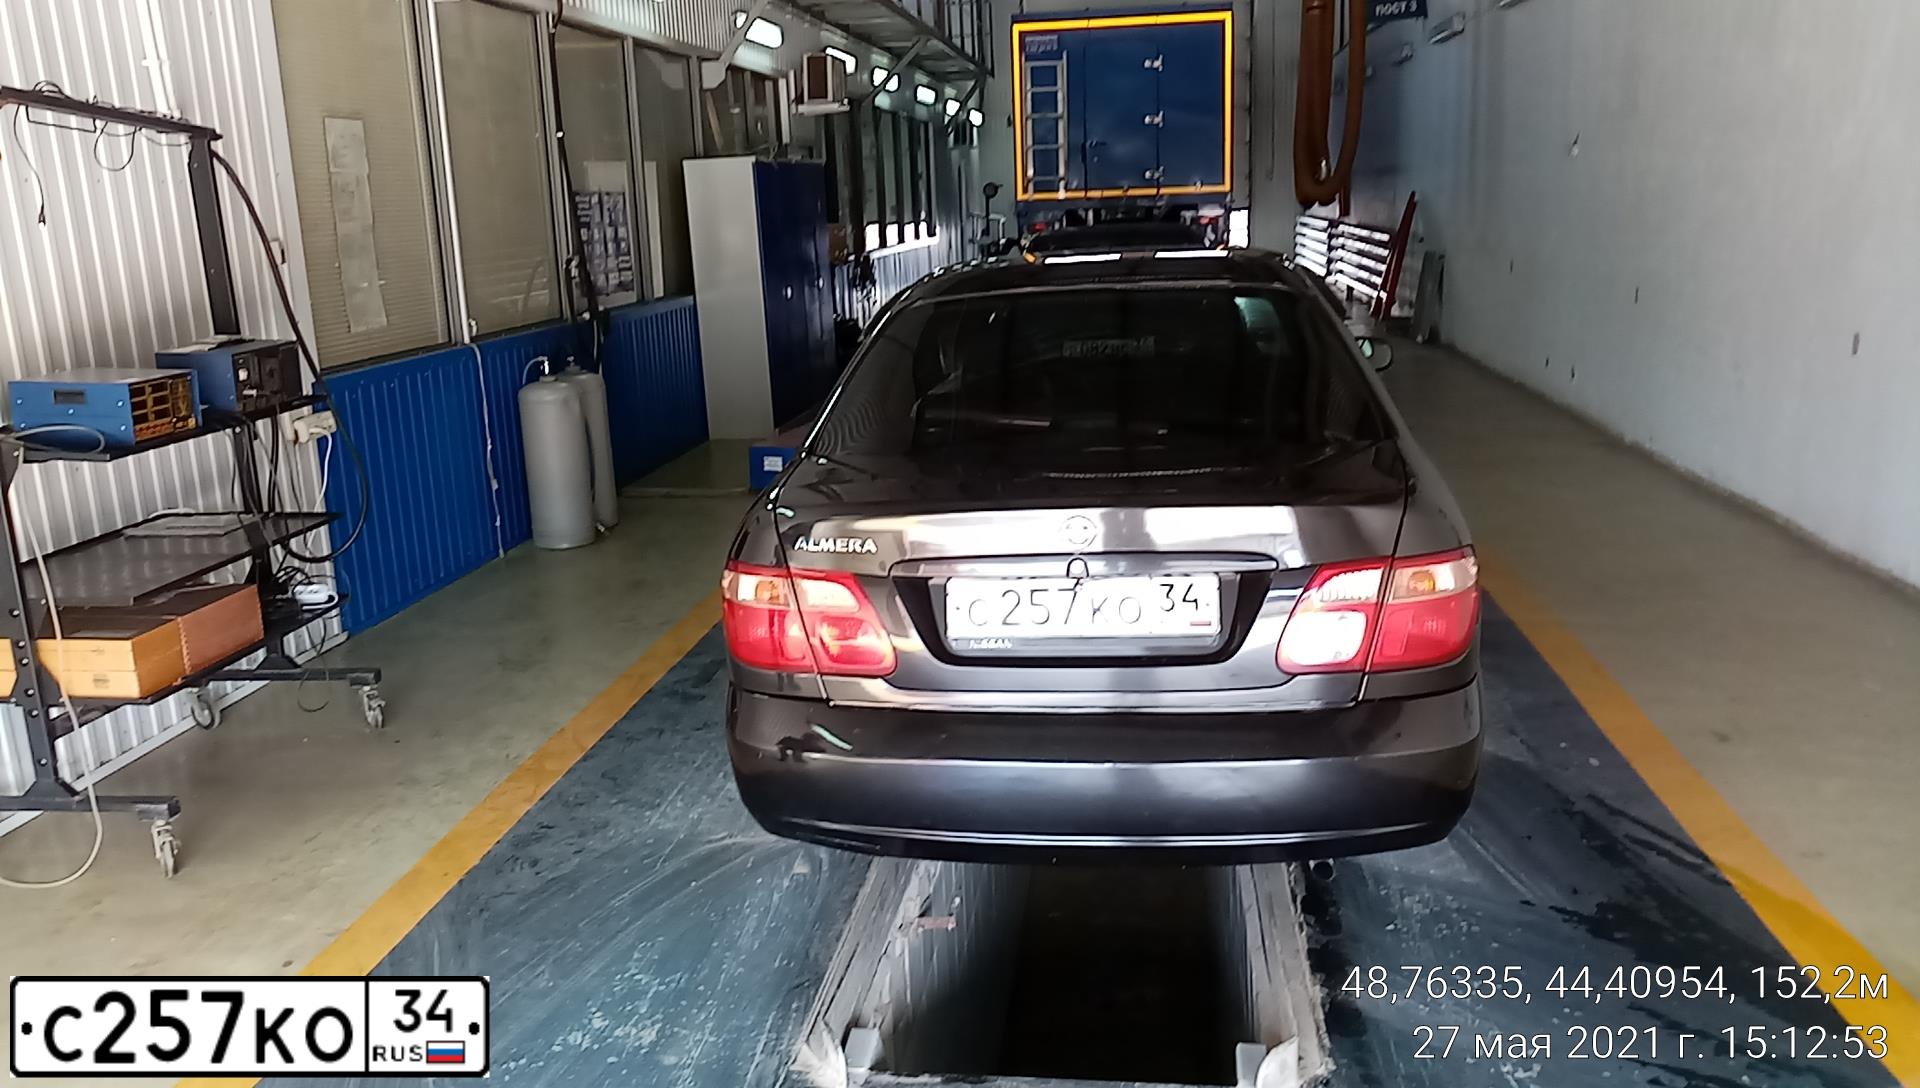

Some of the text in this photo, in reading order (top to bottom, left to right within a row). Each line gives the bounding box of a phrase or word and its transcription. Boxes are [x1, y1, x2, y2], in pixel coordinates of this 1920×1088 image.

[1375, 1, 1407, 17] ПОСТ
[793, 535, 878, 554] ALMERA
[1159, 583, 1199, 612] 34
